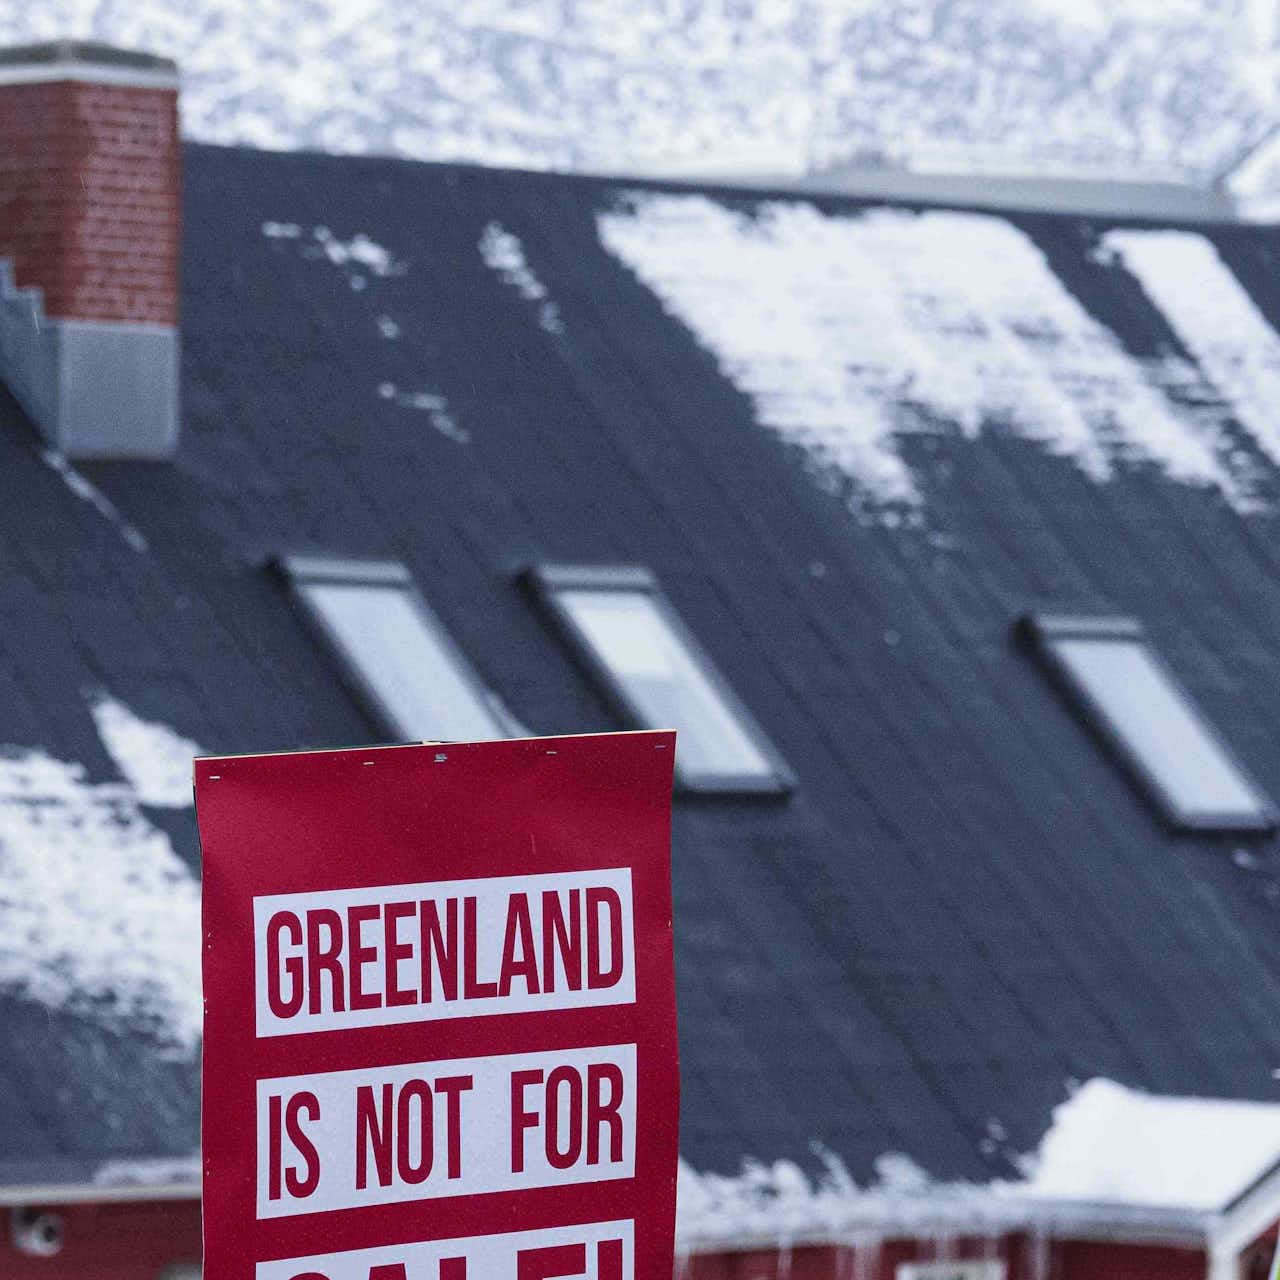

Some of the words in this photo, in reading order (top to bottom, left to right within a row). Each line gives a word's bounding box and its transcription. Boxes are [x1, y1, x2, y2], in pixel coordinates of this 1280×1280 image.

[266, 886, 624, 1019] GREENLAND
[268, 1090, 321, 1201] IS
[355, 1074, 474, 1190] NOT
[510, 1062, 624, 1174] FOR
